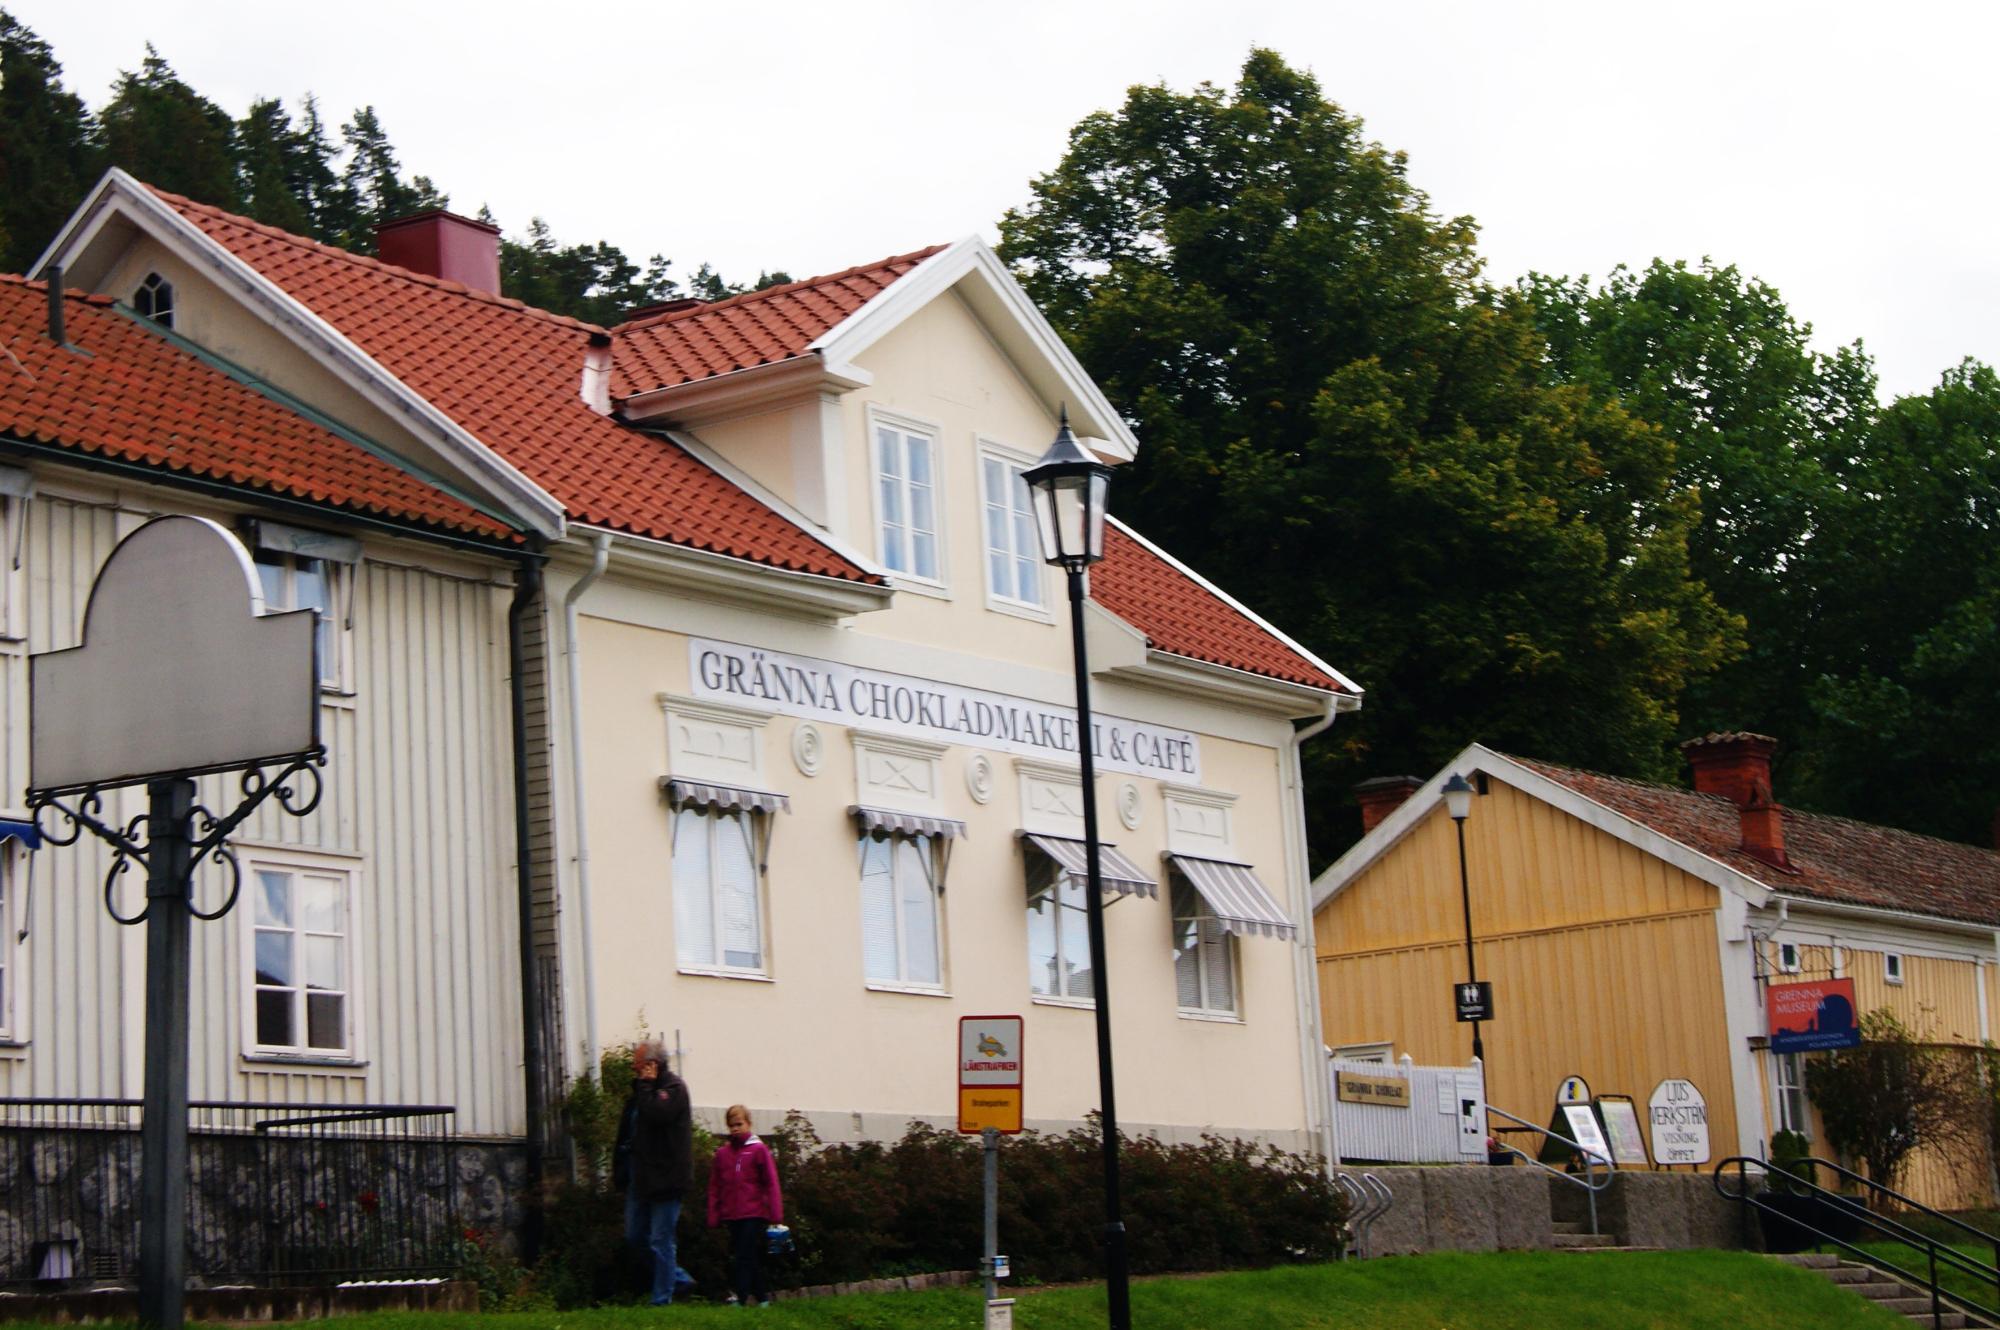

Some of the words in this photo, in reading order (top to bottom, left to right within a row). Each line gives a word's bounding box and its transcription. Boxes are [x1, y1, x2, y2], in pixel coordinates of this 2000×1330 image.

[700, 651, 842, 712] GRÄNNA
[849, 679, 1103, 757] CHOKLADMAKEI
[1110, 727, 1128, 762] &
[1133, 732, 1196, 774] CAFÉ
[1775, 988, 1824, 1002] GRENNA
[1776, 1001, 1826, 1014] MUSEUM
